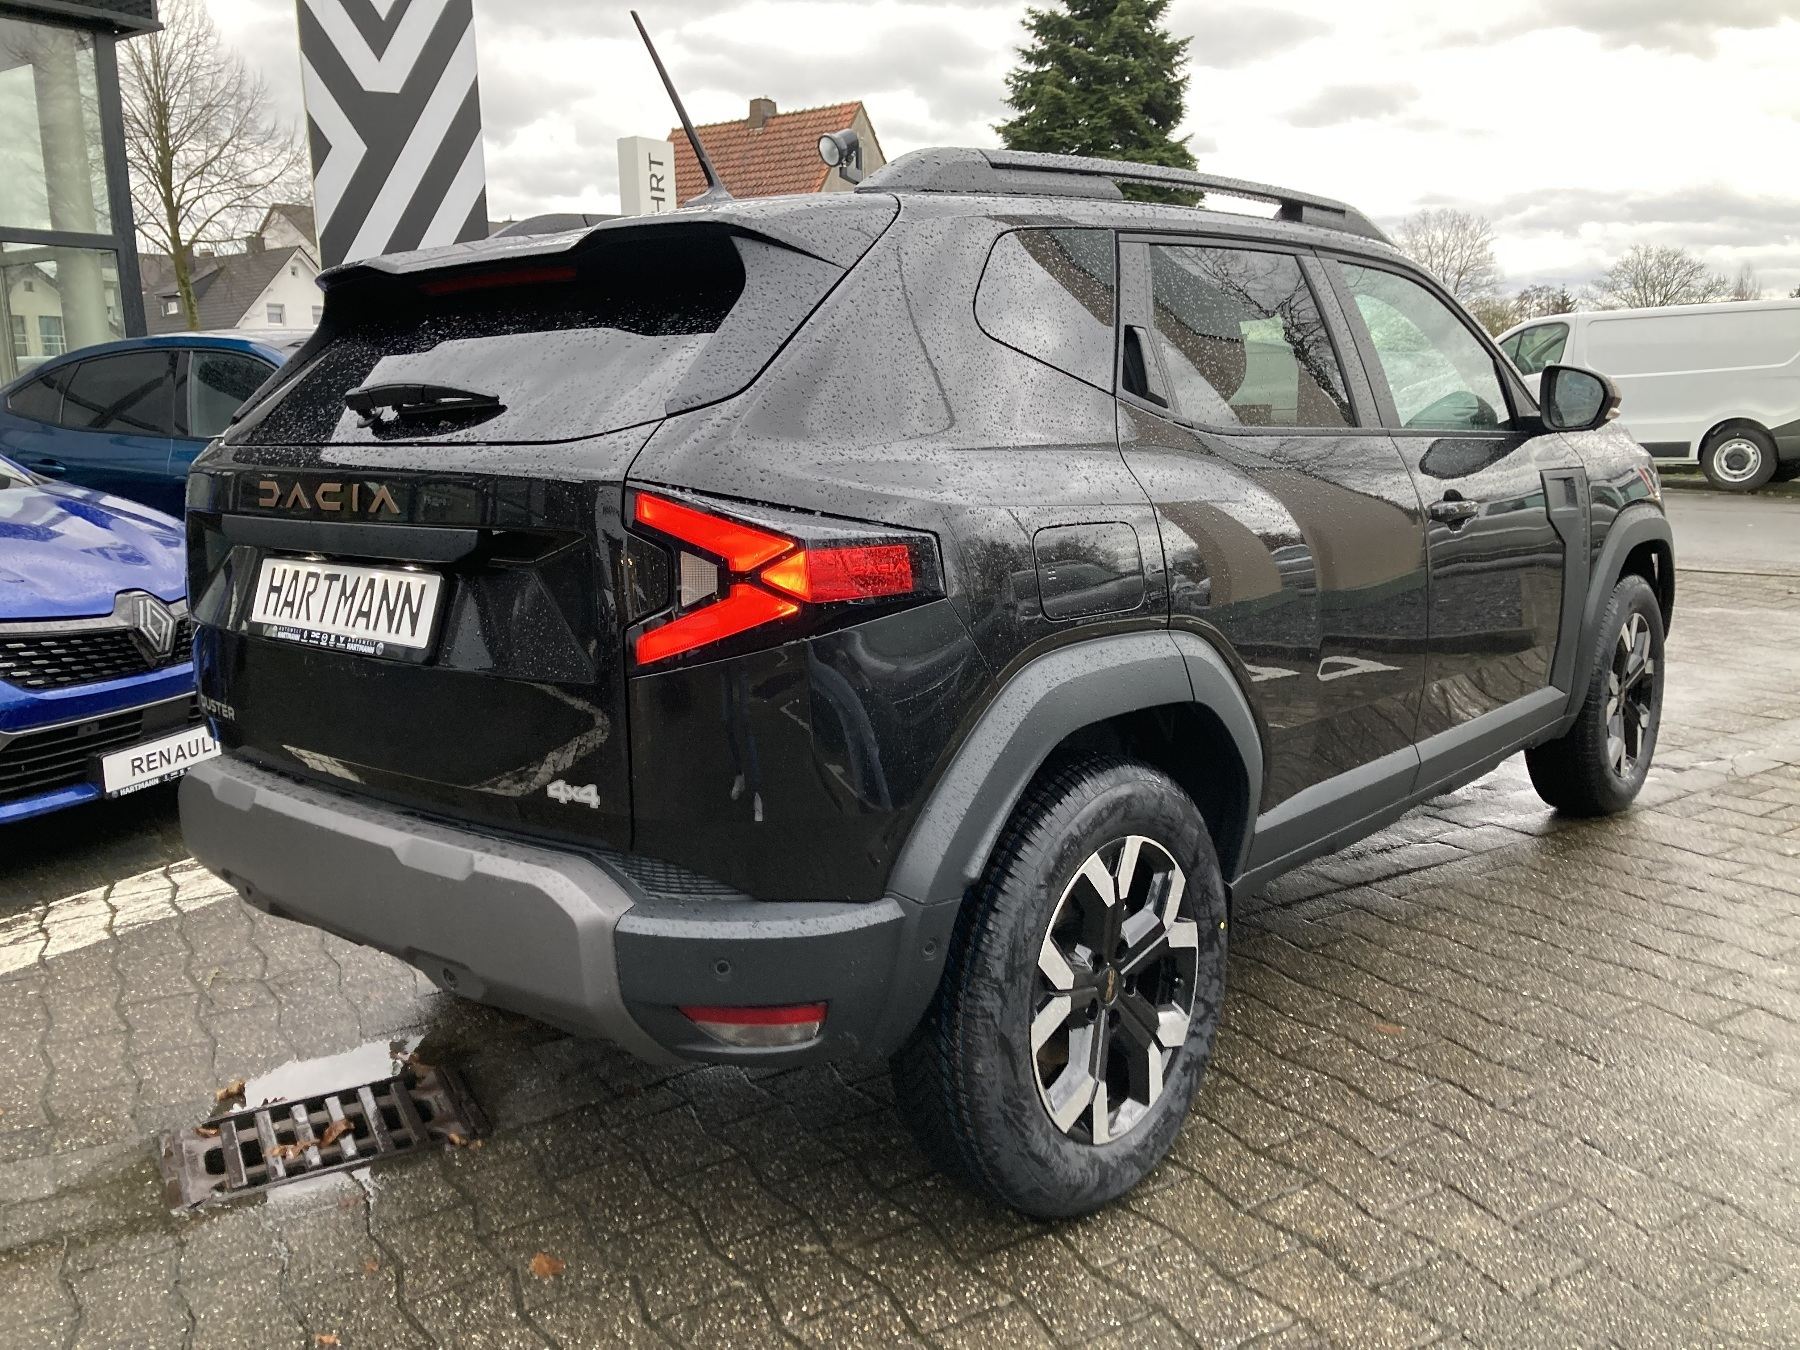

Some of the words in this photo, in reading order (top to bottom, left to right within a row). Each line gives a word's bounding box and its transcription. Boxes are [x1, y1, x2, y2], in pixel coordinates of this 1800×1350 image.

[259, 481, 400, 513] DACIA
[263, 567, 426, 637] HARTMANN
[346, 643, 375, 654] HARTMANN
[120, 778, 159, 796] HARTMANN
[547, 779, 600, 809] 4x4
